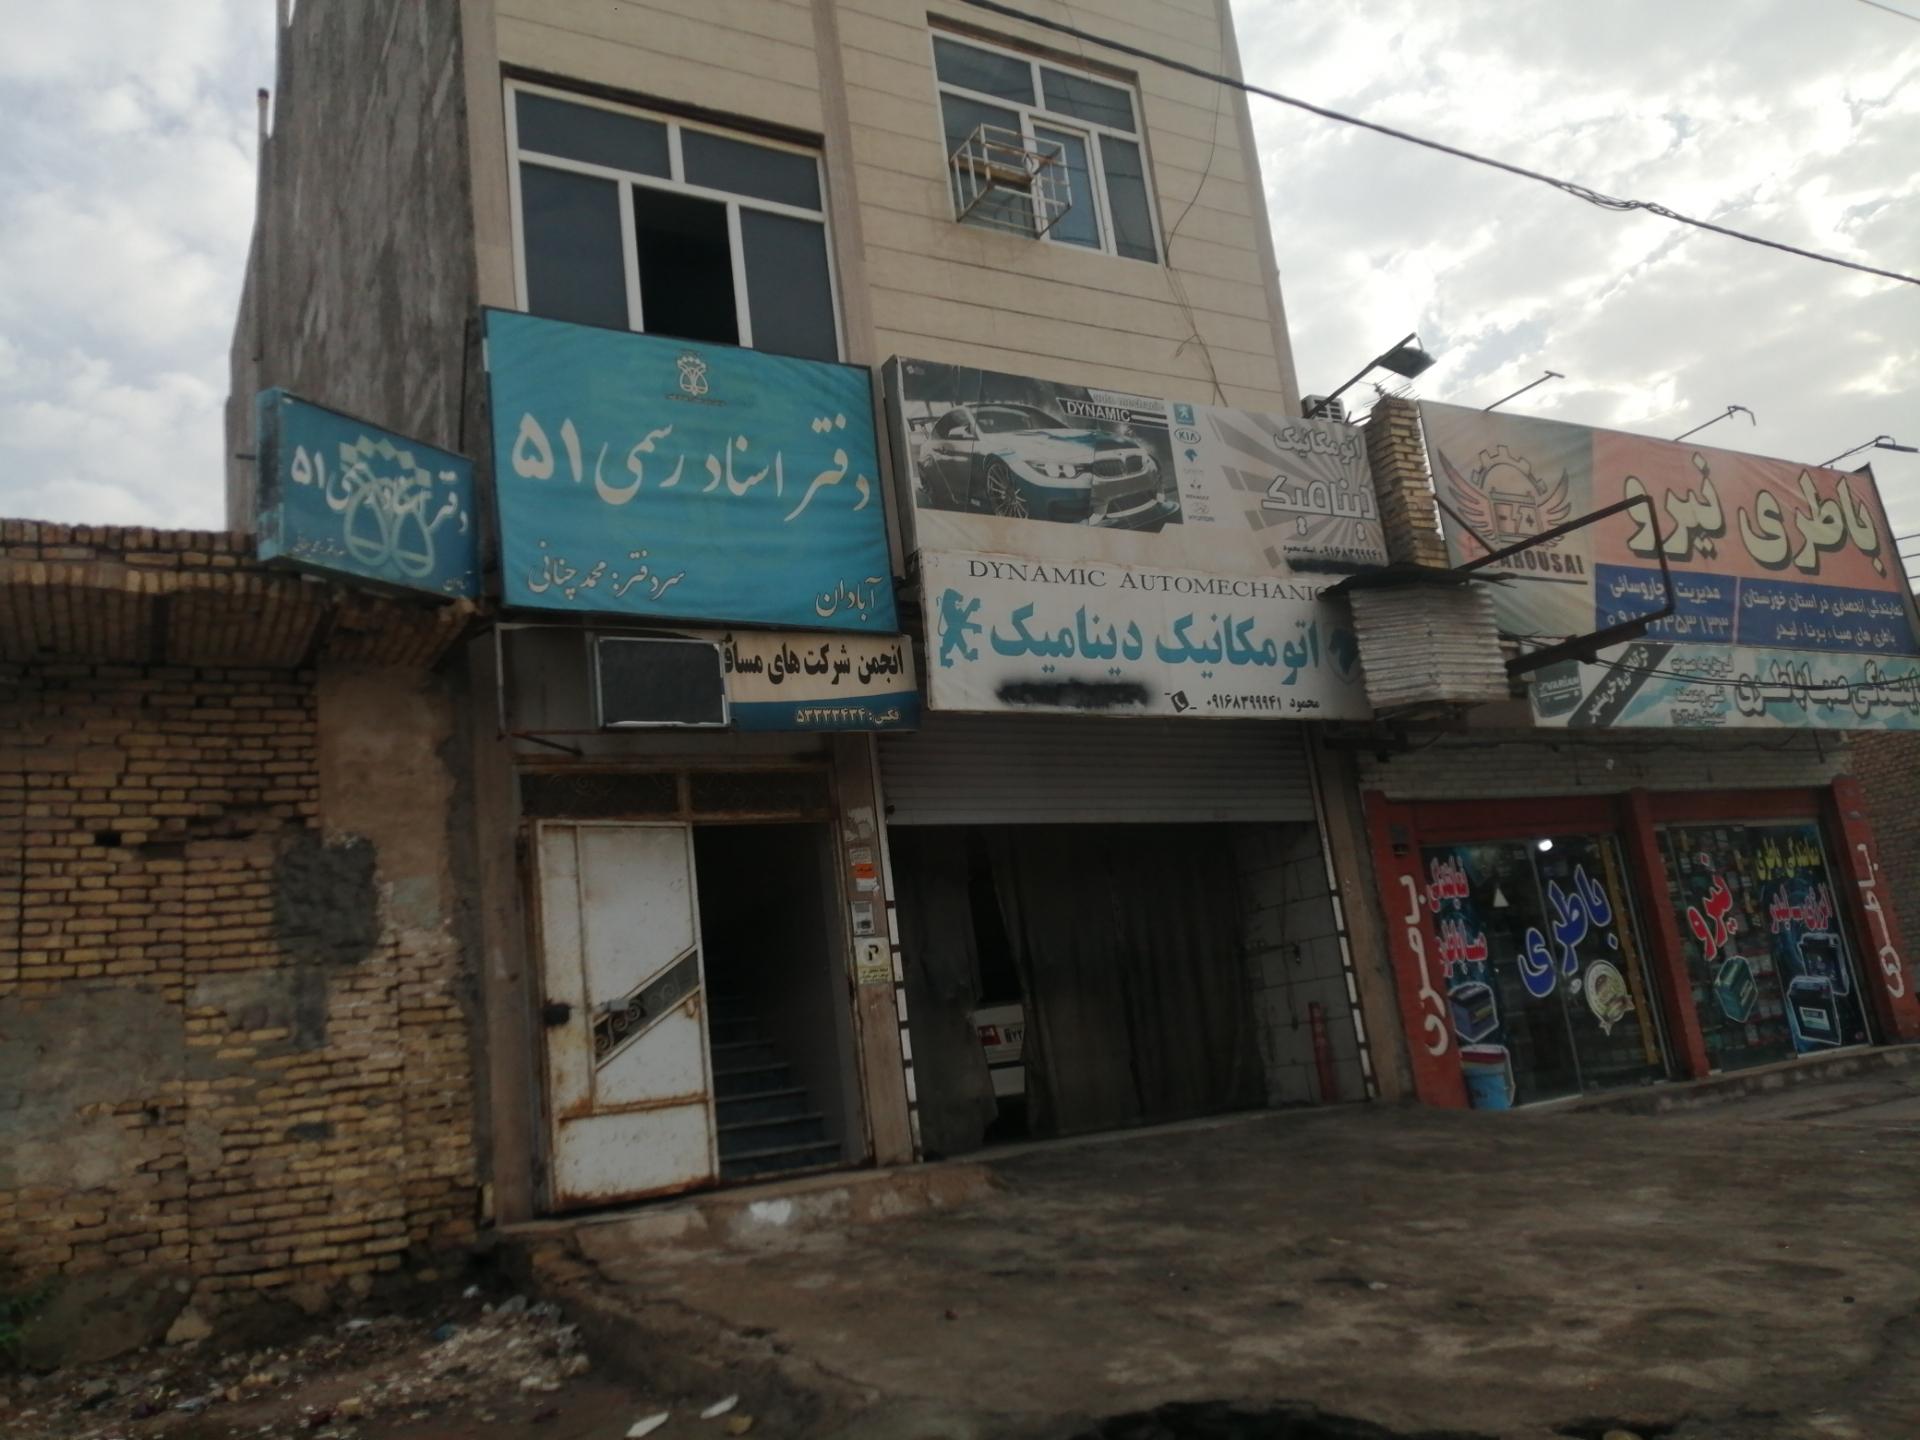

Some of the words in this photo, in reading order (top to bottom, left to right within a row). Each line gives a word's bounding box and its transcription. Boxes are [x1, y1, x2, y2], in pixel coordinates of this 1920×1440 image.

[1066, 400, 1131, 422] DYNAMIC
[291, 443, 325, 489] ۵۱
[512, 413, 584, 483] ۵۱
[595, 424, 685, 506] رسمی
[703, 436, 784, 497] اسناد
[784, 414, 871, 521] دفتر
[1623, 452, 1729, 560] نیرو
[1737, 468, 1888, 578] باطری
[579, 560, 607, 590] محمد
[968, 559, 1105, 588] DYNAMIC
[1488, 548, 1585, 575] AROUSAI
[814, 576, 884, 622] آبادان
[989, 601, 1144, 676] دینامیک
[1155, 611, 1320, 685] اتومکانیک
[768, 641, 801, 685] های
[804, 643, 851, 685] شرکت
[858, 643, 904, 684] انجمن
[1290, 698, 1320, 713] محمود
[1518, 863, 1619, 999] باطری
